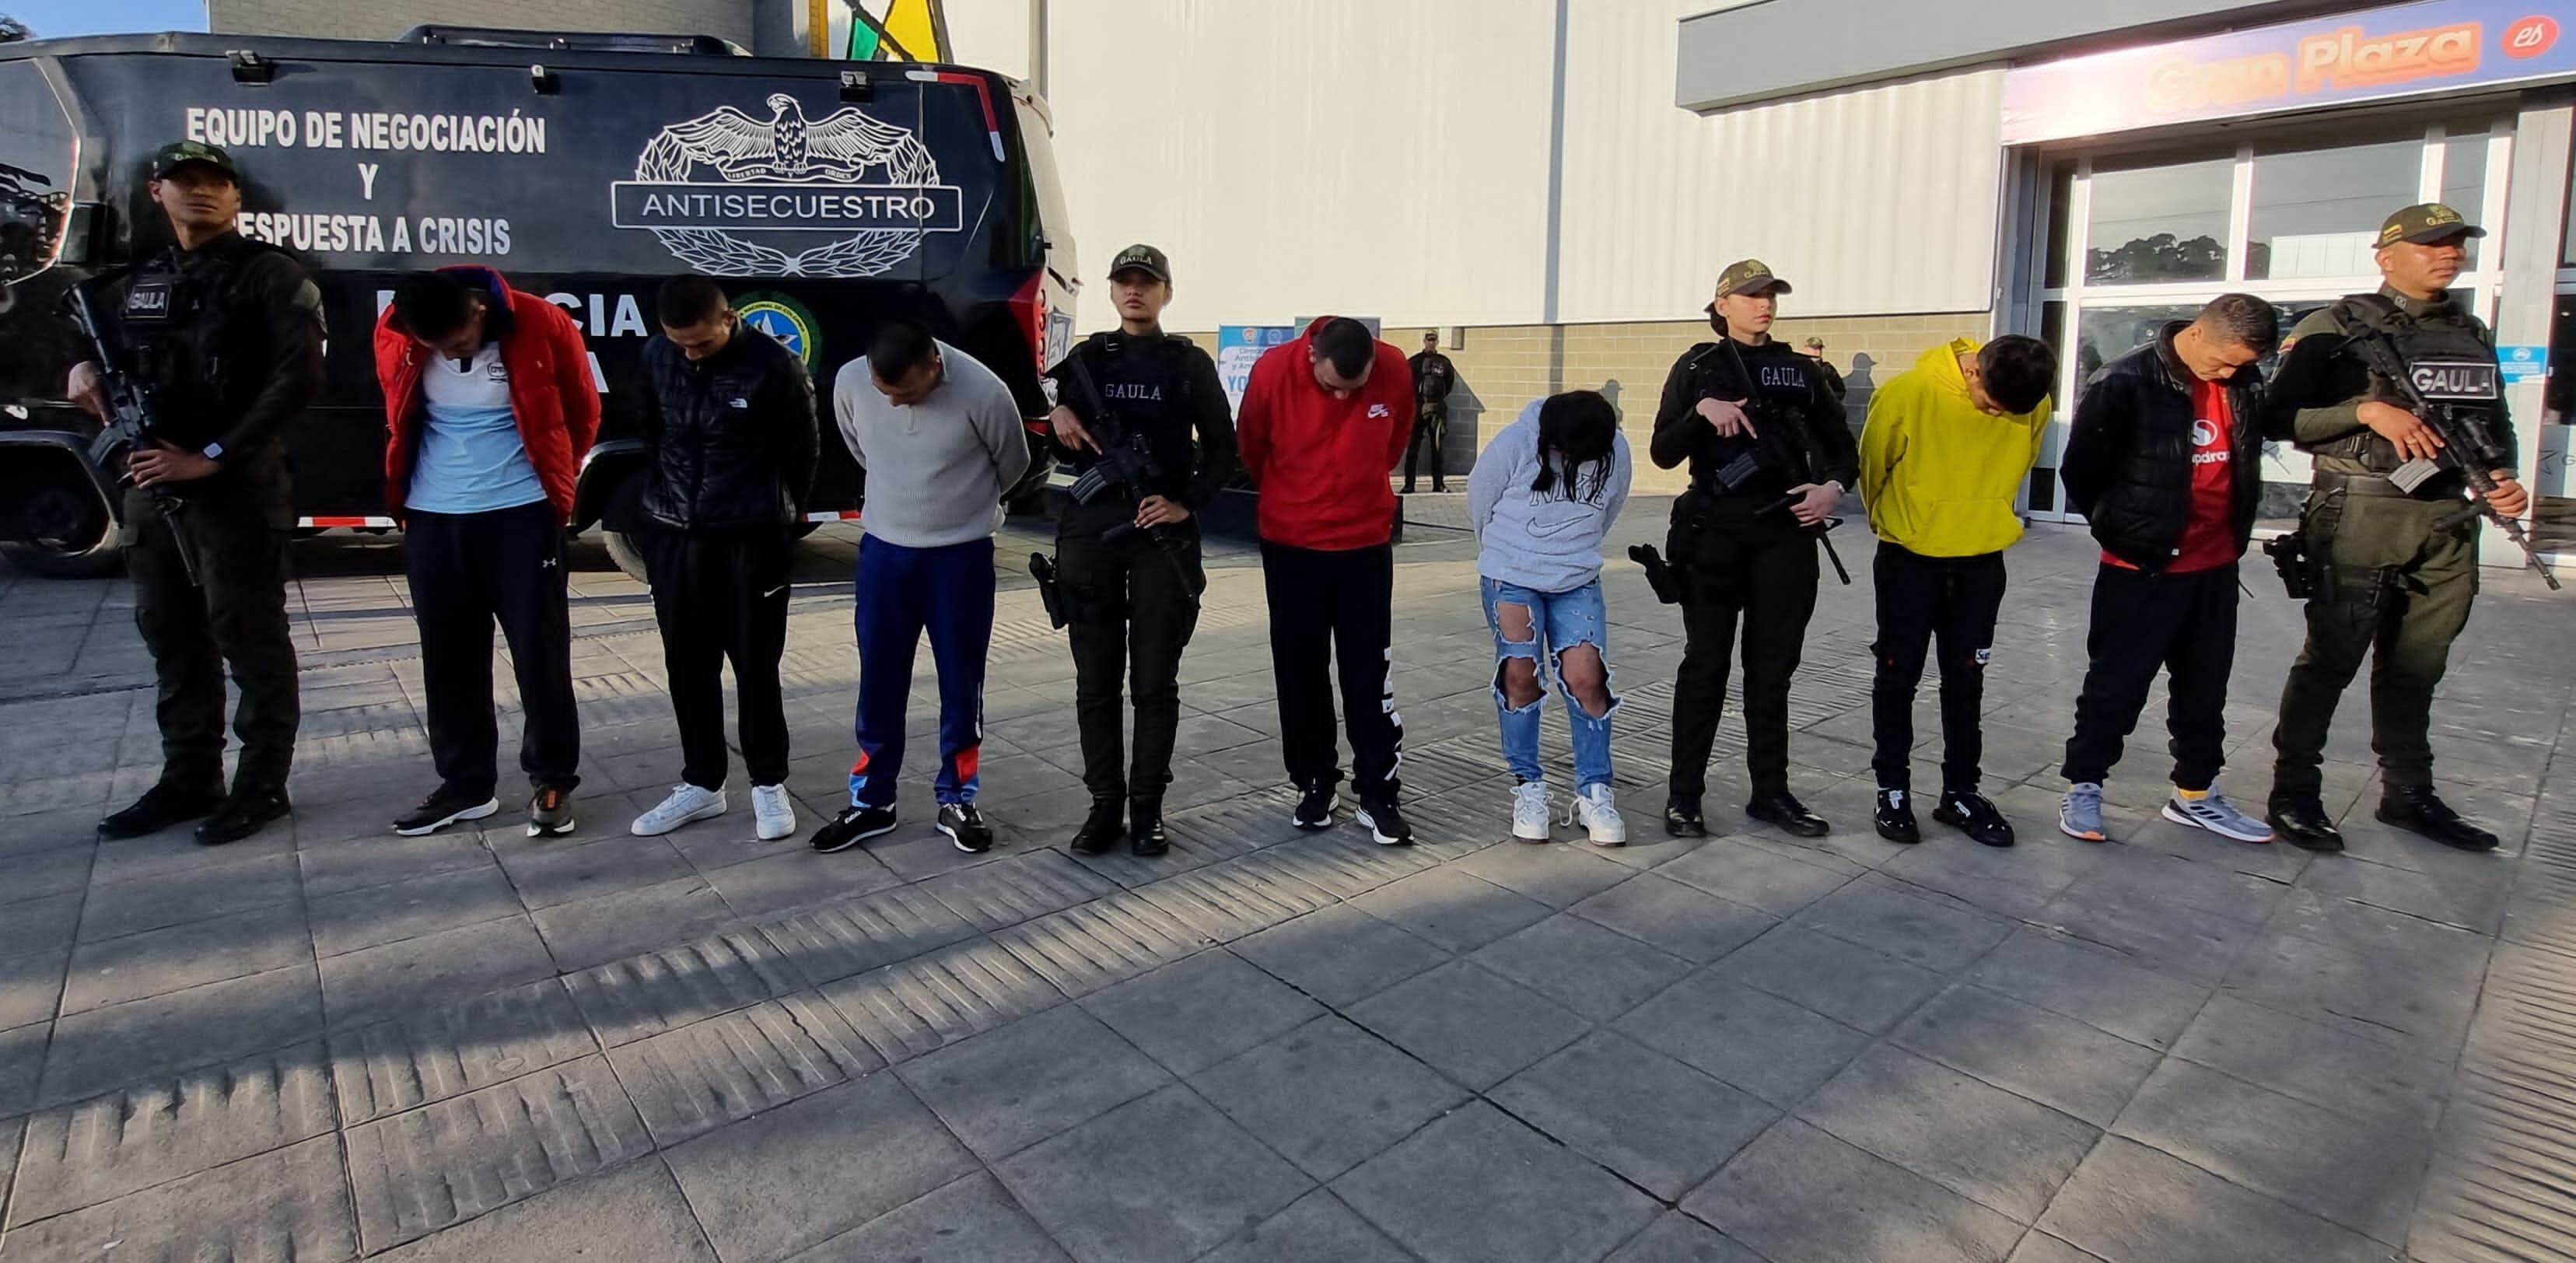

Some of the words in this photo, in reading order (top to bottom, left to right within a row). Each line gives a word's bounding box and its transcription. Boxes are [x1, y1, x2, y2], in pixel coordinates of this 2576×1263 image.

[2513, 23, 2544, 48] es
[2302, 29, 2472, 74] Plaza
[187, 107, 297, 149] EQUIPO
[306, 111, 343, 149] DE
[352, 108, 545, 153] NEGOCIACIÓN
[358, 163, 379, 200] Y
[728, 168, 767, 179] LIBERTAD
[824, 169, 852, 180] ORDEN
[642, 192, 936, 220] ANTISECUESTRO
[232, 212, 384, 252] ESPUESTA
[391, 216, 412, 253] A
[419, 217, 511, 254] CRISIS
[1119, 255, 1153, 265] GAULA
[129, 292, 165, 310] GAULA
[1761, 366, 1805, 388] GAULA
[2412, 368, 2494, 392] GAULA
[1105, 383, 1163, 401] GAULA
